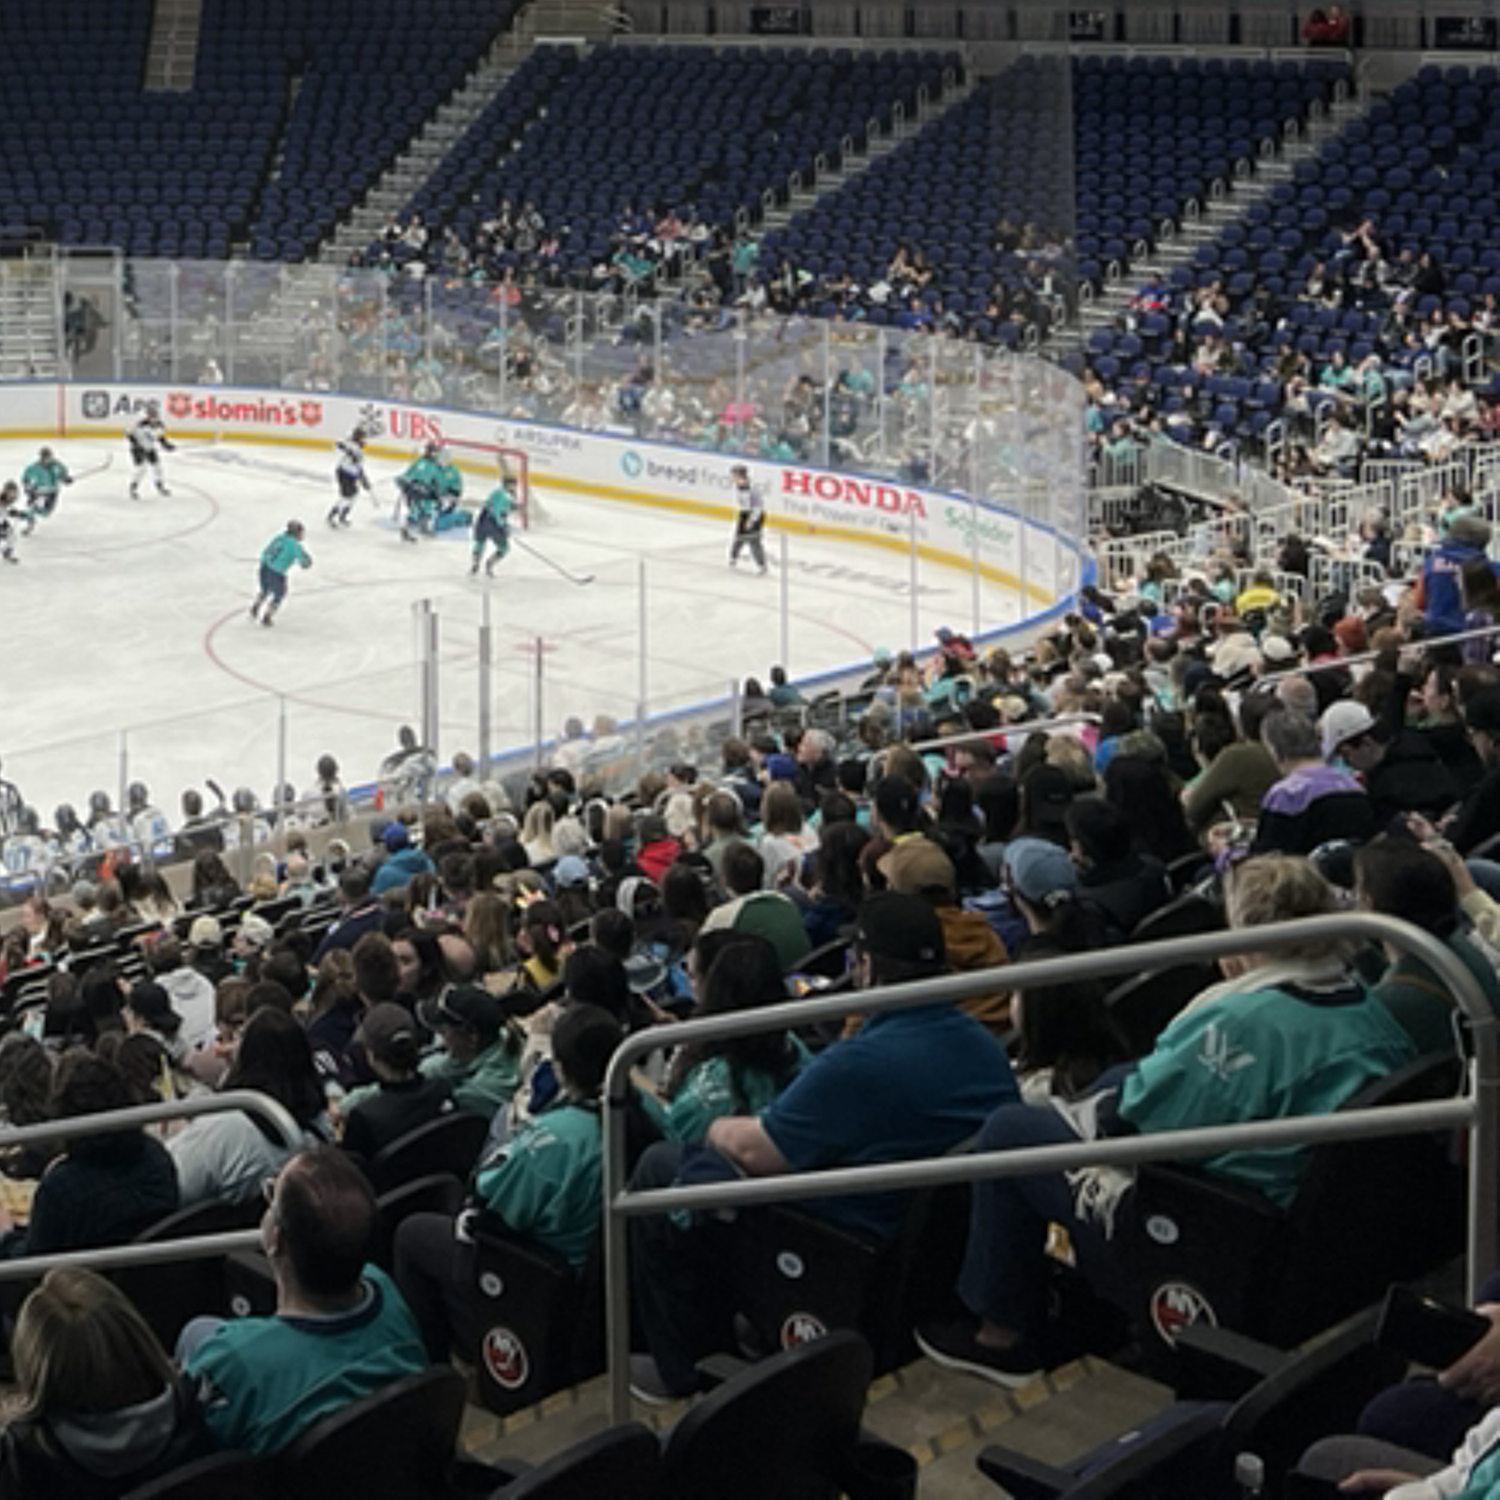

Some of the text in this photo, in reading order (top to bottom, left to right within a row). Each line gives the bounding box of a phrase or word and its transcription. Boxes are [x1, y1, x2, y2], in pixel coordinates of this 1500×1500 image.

[194, 397, 297, 426] slomin's
[389, 410, 441, 440] UBS
[646, 460, 697, 485] bread
[780, 470, 927, 519] HONDA
